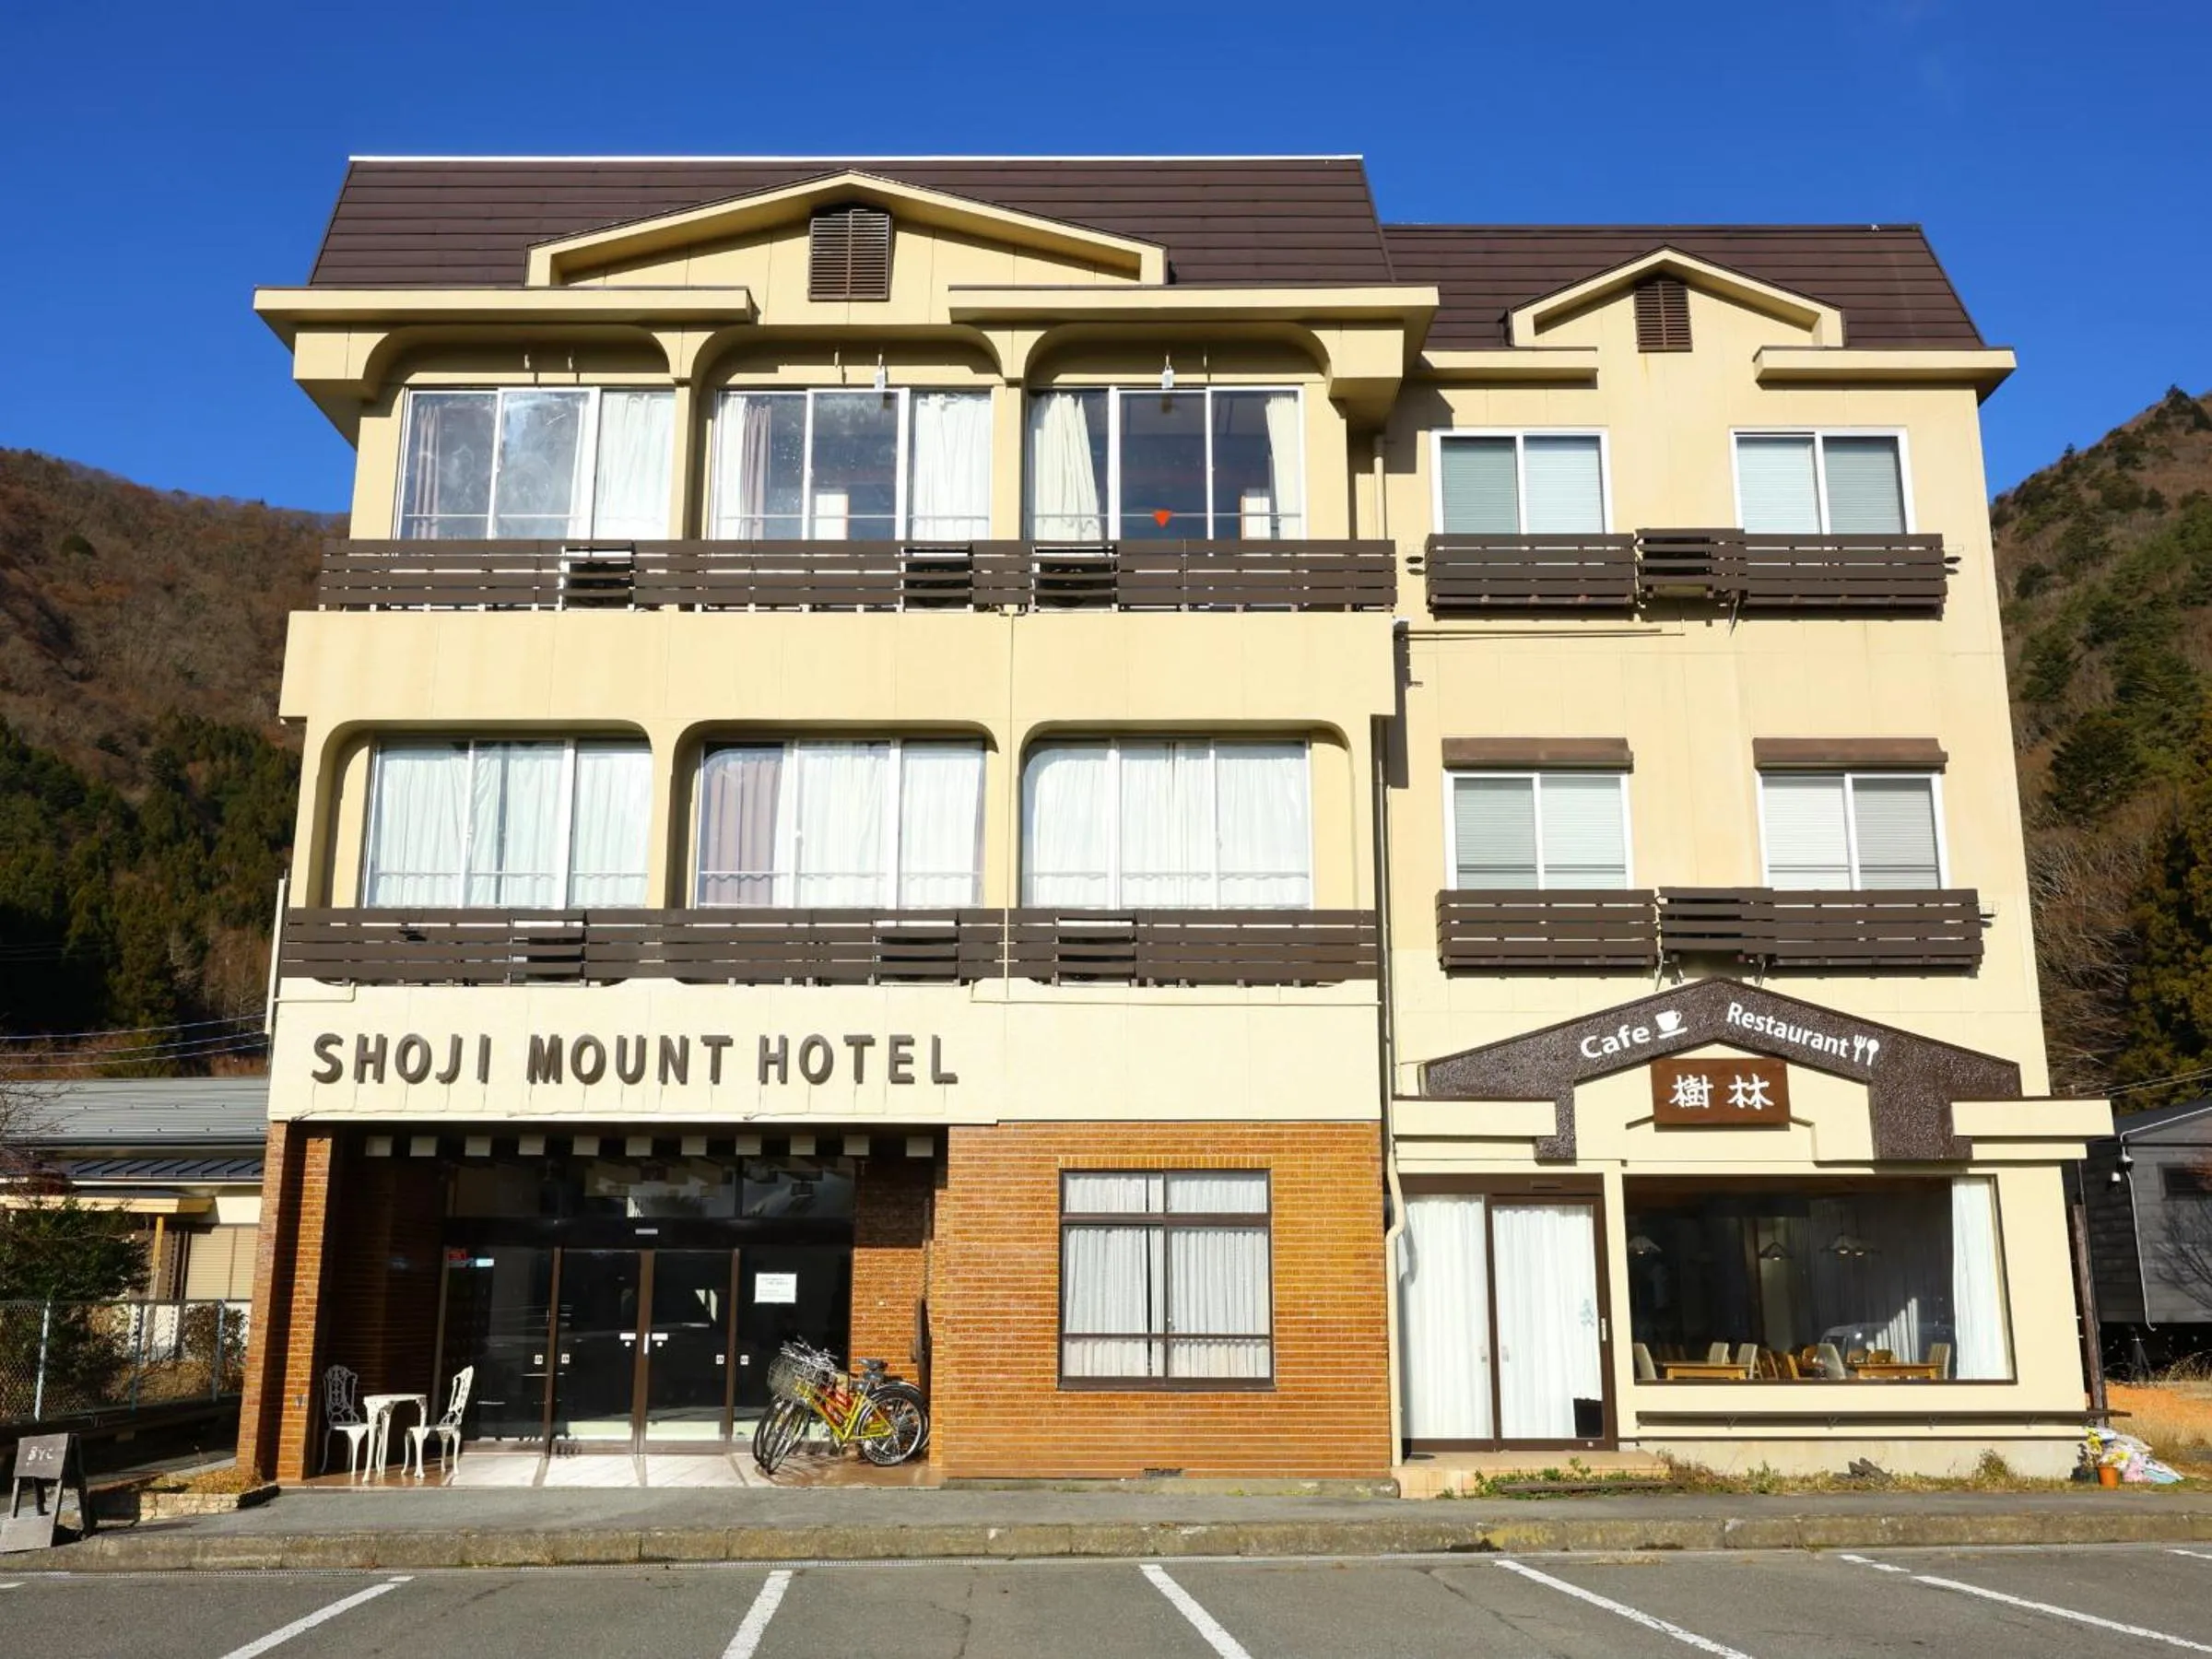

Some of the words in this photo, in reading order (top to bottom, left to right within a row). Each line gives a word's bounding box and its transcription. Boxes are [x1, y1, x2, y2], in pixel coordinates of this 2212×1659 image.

[1580, 1024, 1651, 1059] Cafe
[1726, 1002, 1848, 1058] Restaurant
[312, 1033, 491, 1085] SHOJI
[527, 1033, 734, 1086] MOUNT
[758, 1033, 959, 1085] HOTEL
